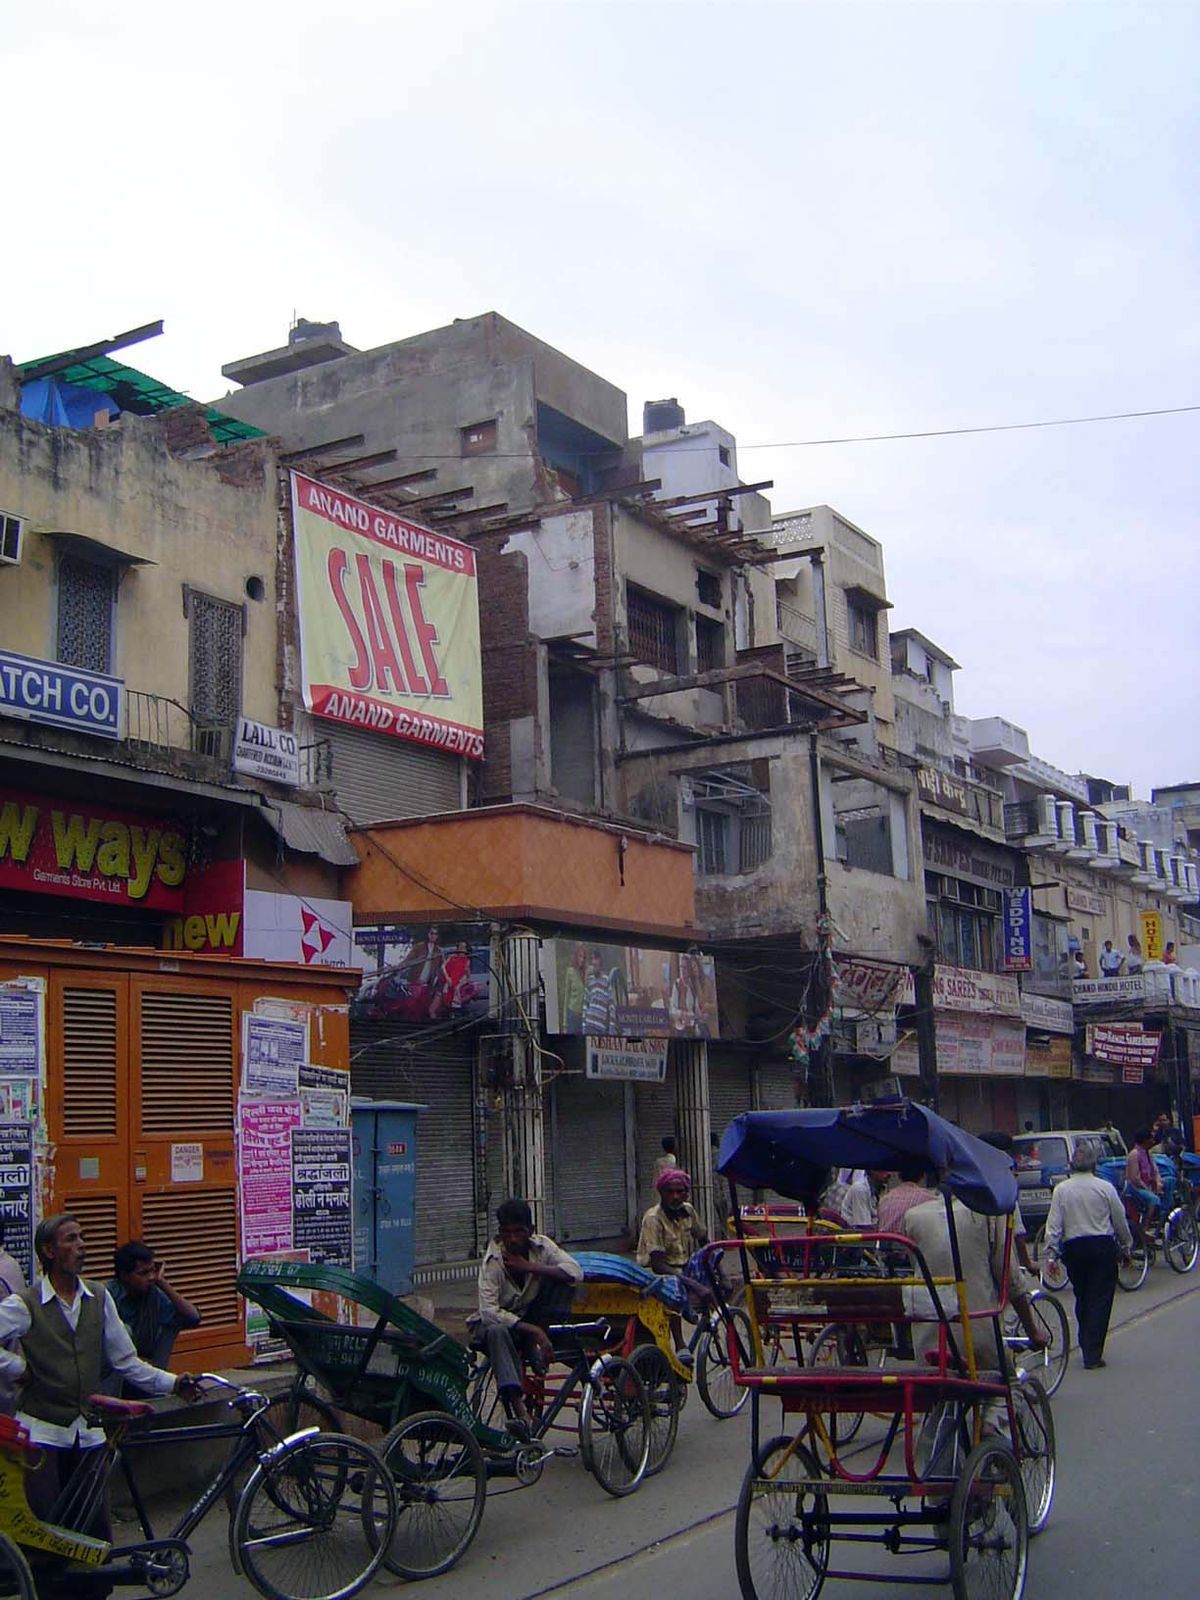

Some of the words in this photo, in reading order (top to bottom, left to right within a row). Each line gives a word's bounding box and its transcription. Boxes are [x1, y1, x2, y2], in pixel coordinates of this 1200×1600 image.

[308, 487, 369, 529] ANAND
[374, 518, 465, 569] GARMENTS
[328, 547, 452, 698] SALE
[0, 666, 61, 710] TCH
[71, 683, 115, 722] CO.
[242, 722, 276, 749] LALL
[324, 692, 394, 729] ANAND
[396, 712, 484, 756] GARMENTS
[51, 810, 188, 898] ways
[72, 875, 91, 889] Store
[162, 911, 240, 950] new
[1005, 888, 1026, 957] WEDDING
[1145, 920, 1159, 958] HOTEL
[946, 978, 976, 999] SAREES
[1120, 979, 1143, 991] HOTEL
